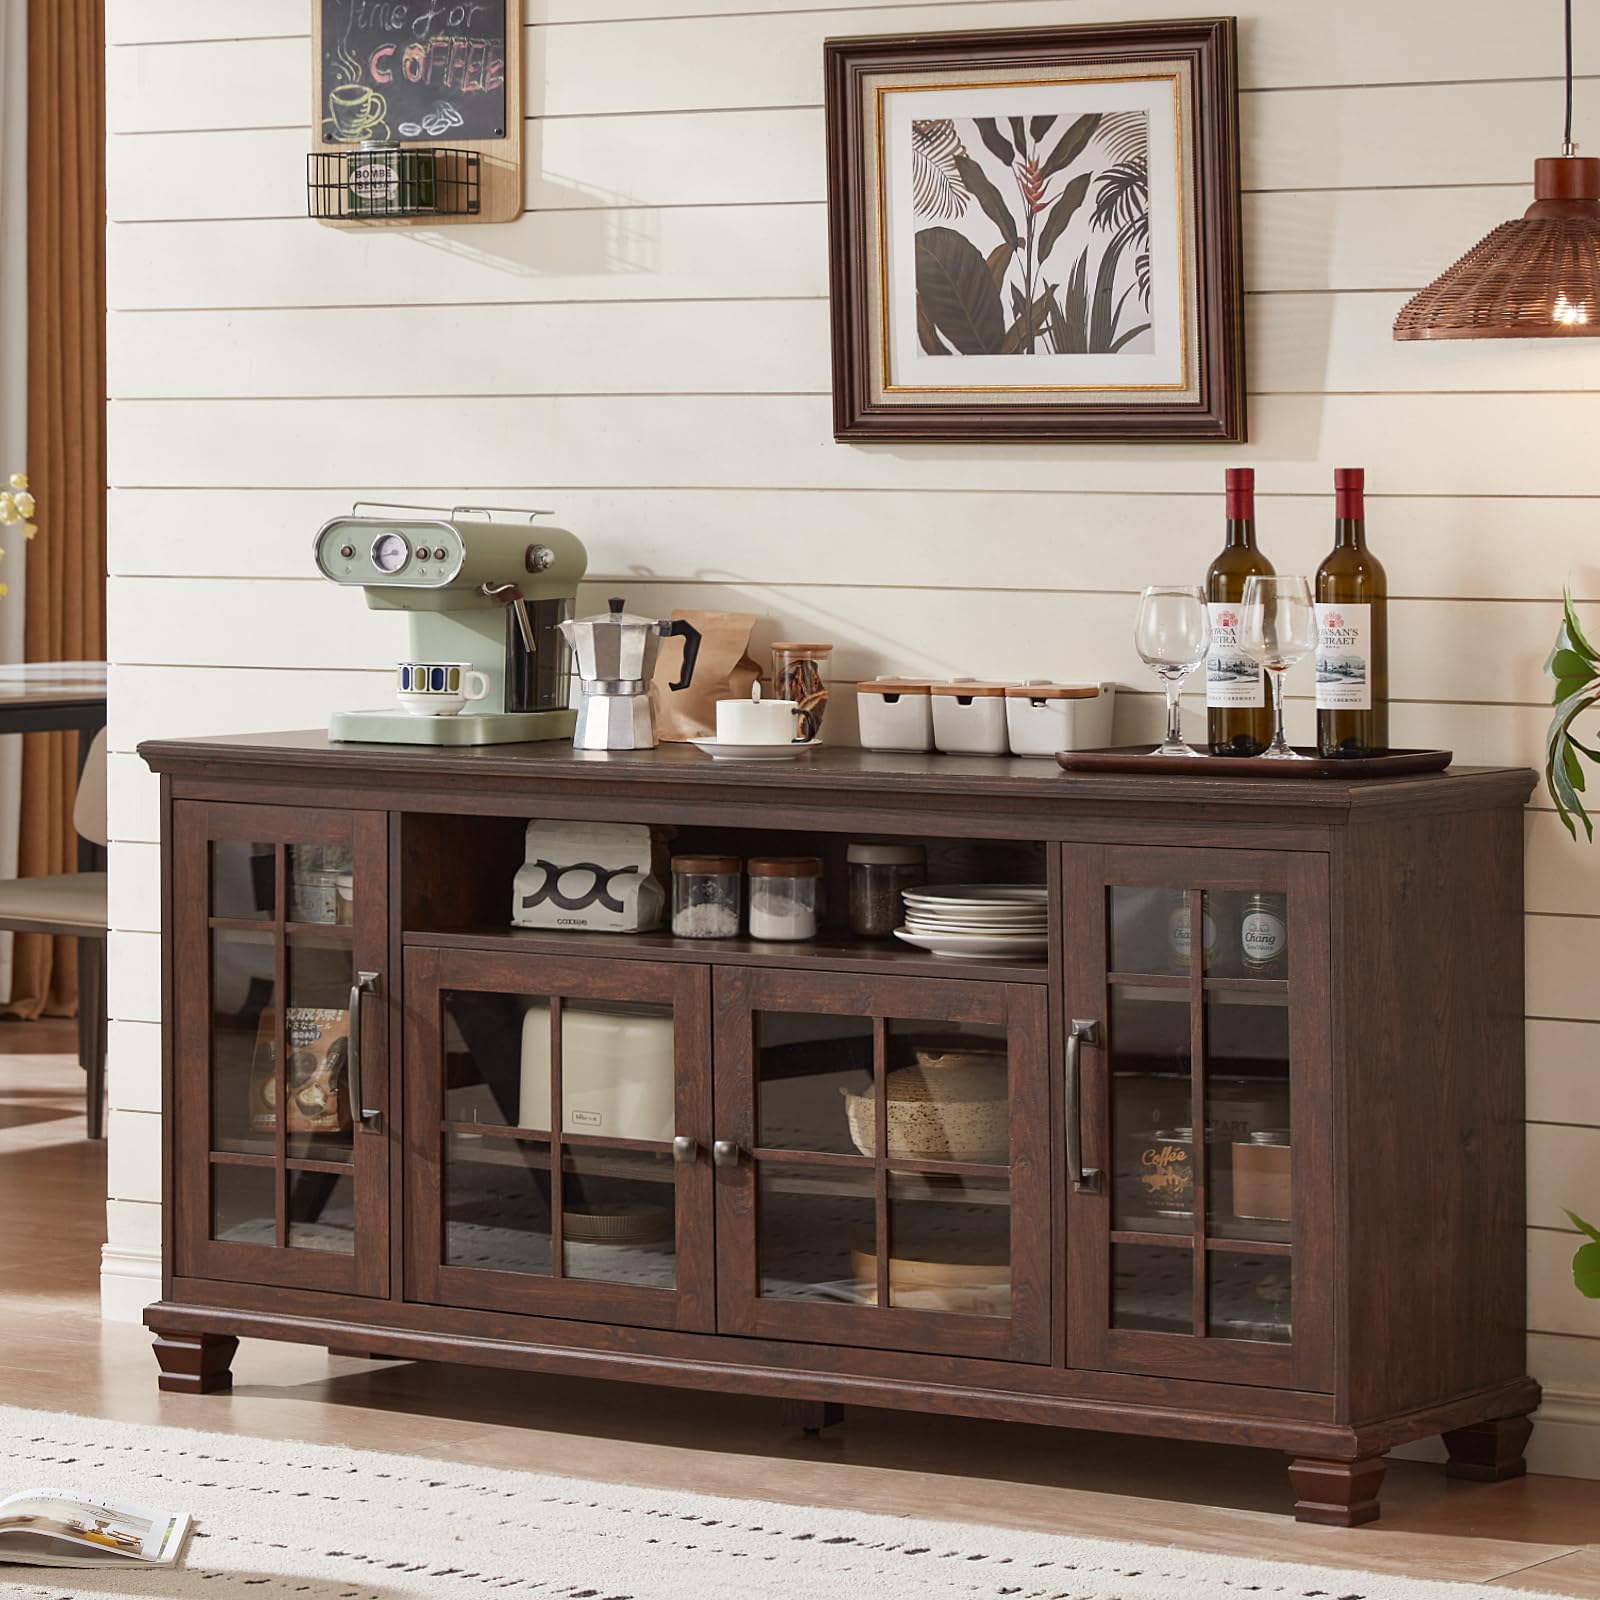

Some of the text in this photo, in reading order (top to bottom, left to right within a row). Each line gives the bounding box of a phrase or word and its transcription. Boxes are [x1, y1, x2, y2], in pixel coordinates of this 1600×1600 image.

[349, 0, 408, 31] ime
[369, 34, 505, 92] COFFEE
[1141, 1145, 1188, 1167] Coffee
